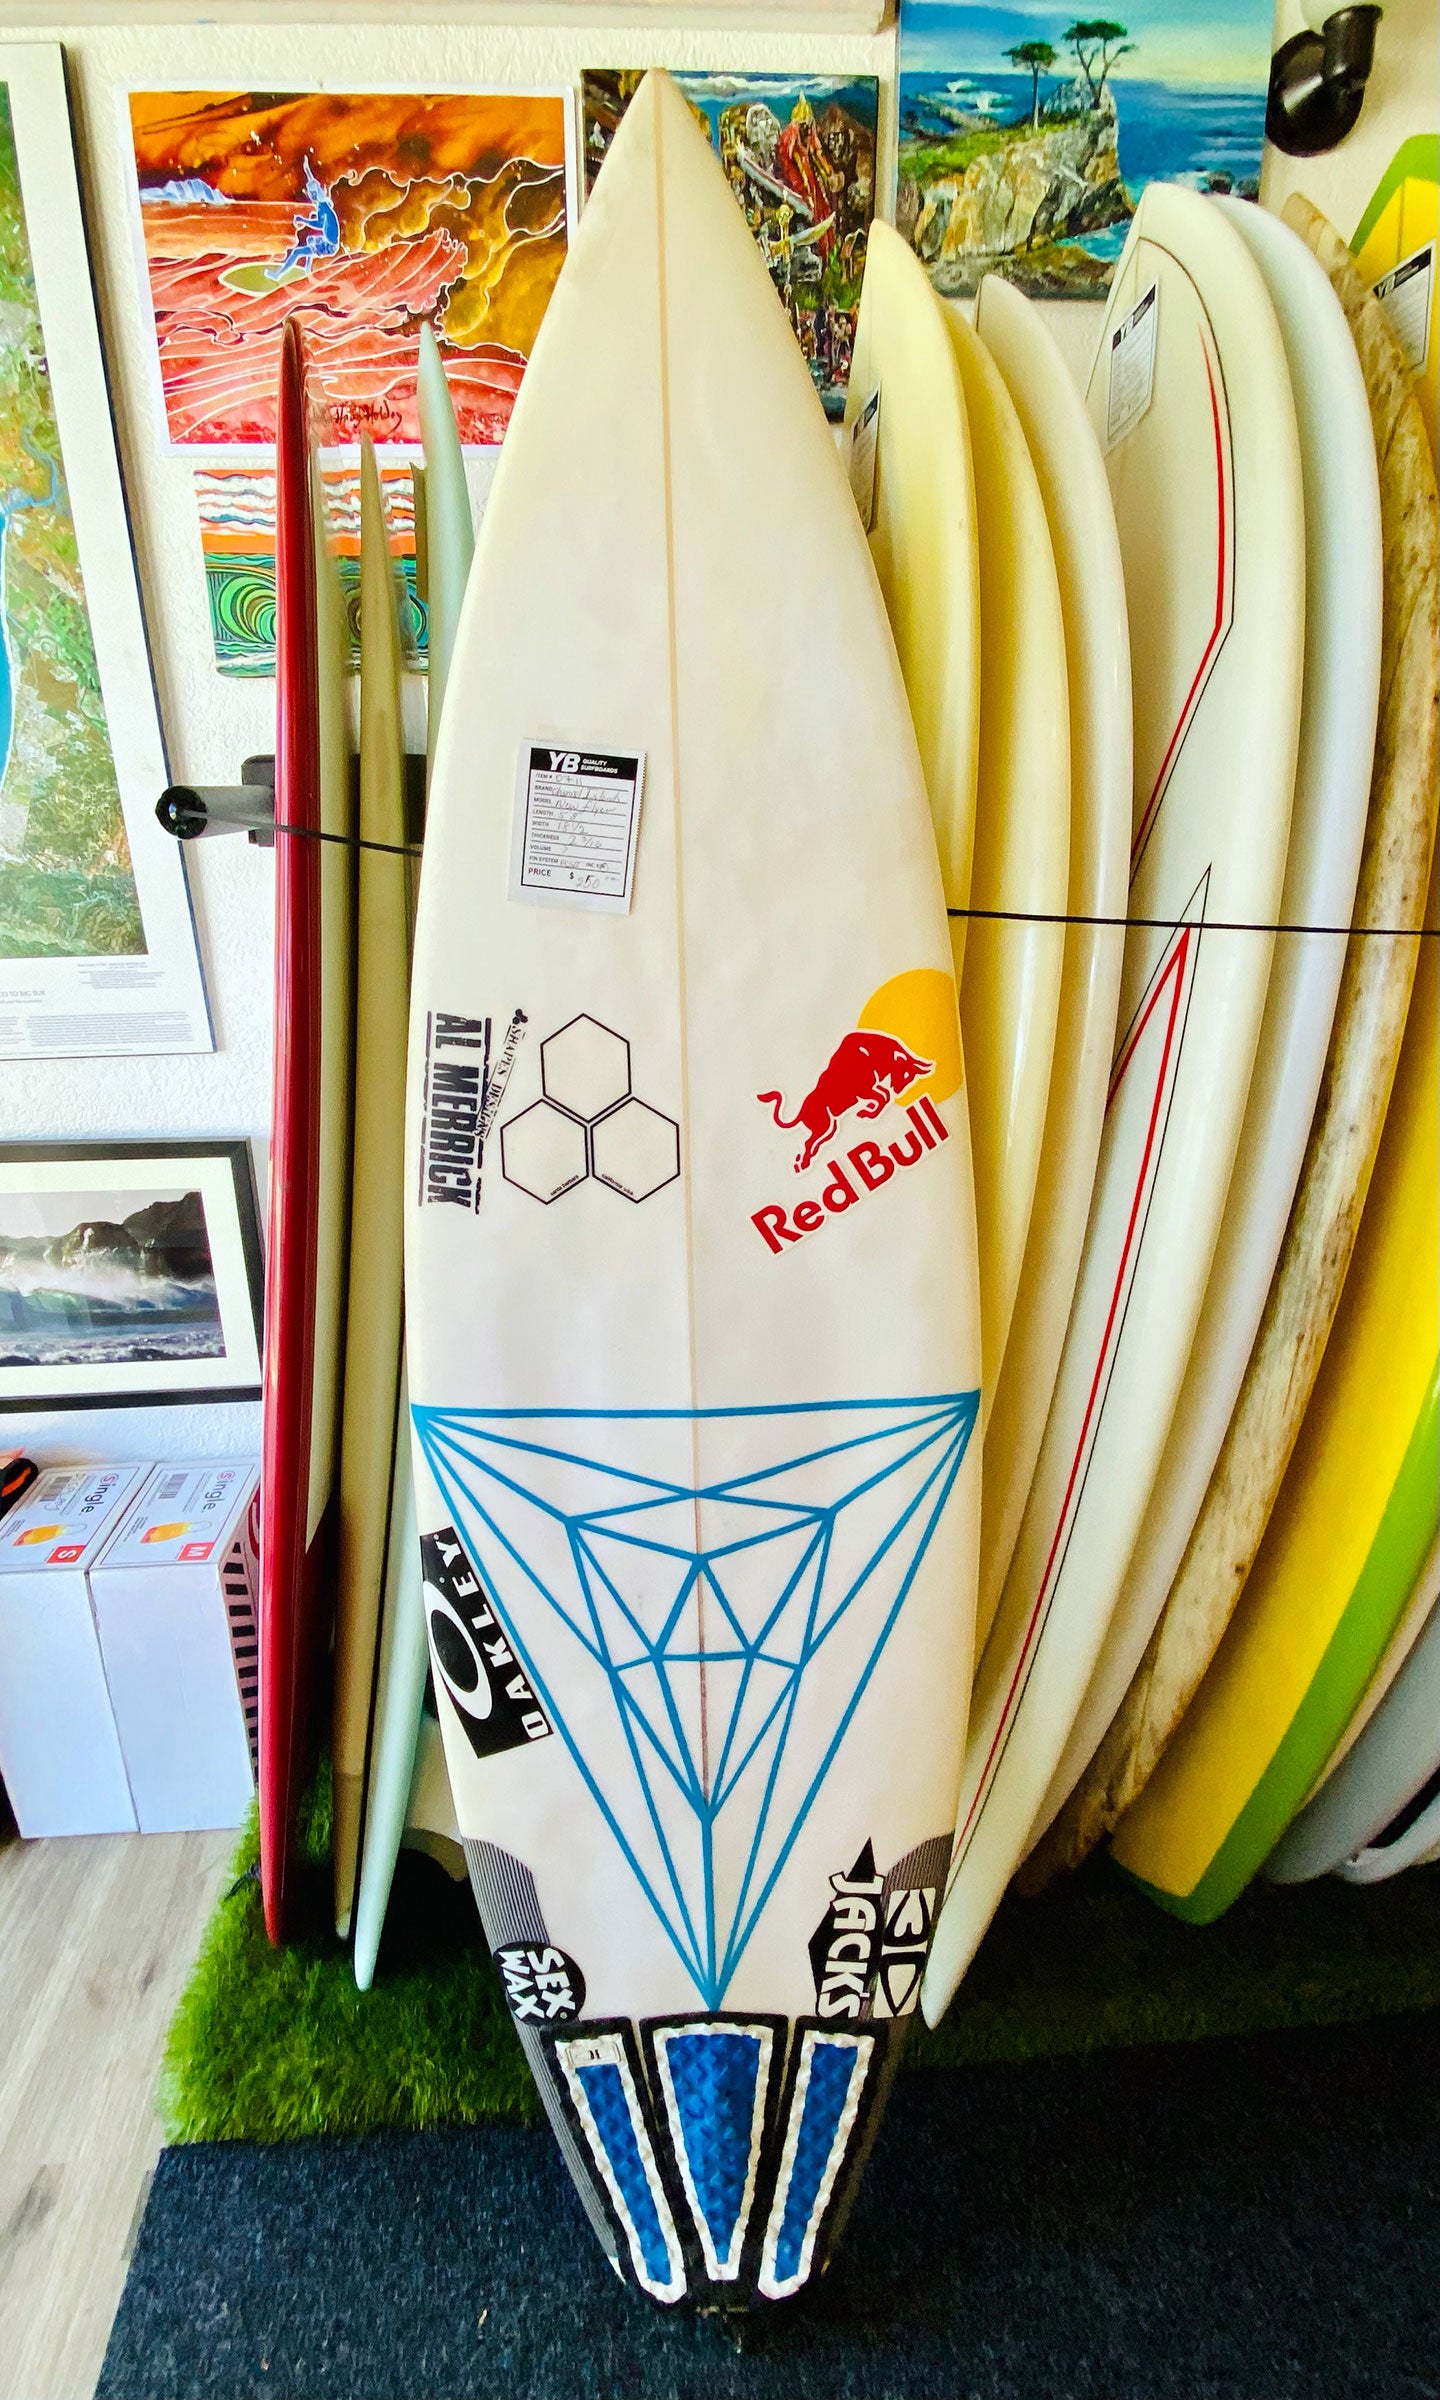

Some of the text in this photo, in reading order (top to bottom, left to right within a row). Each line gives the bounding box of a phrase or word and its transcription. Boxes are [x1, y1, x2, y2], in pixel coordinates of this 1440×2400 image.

[549, 751, 581, 773] YB
[580, 765, 618, 774] SURFBOARDS
[582, 758, 608, 766] QUALITY
[532, 809, 553, 817] LENGTH
[531, 833, 559, 841] THICKNESS
[530, 844, 551, 852] VOLUME
[539, 856, 558, 864] SYSTEM
[528, 867, 551, 877] PRICE
[474, 1025, 522, 1138] SHAPES DESIGNS
[427, 1012, 482, 1208] AL MERRICK
[750, 1096, 949, 1254] Red Bull
[81, 1473, 120, 1514] Single
[203, 1470, 236, 1511] Single
[57, 1549, 77, 1559] S
[186, 1546, 208, 1557] M
[435, 1541, 549, 1740] OAKLEY
[498, 1950, 545, 2019] WAX
[526, 1948, 576, 2019] SEX
